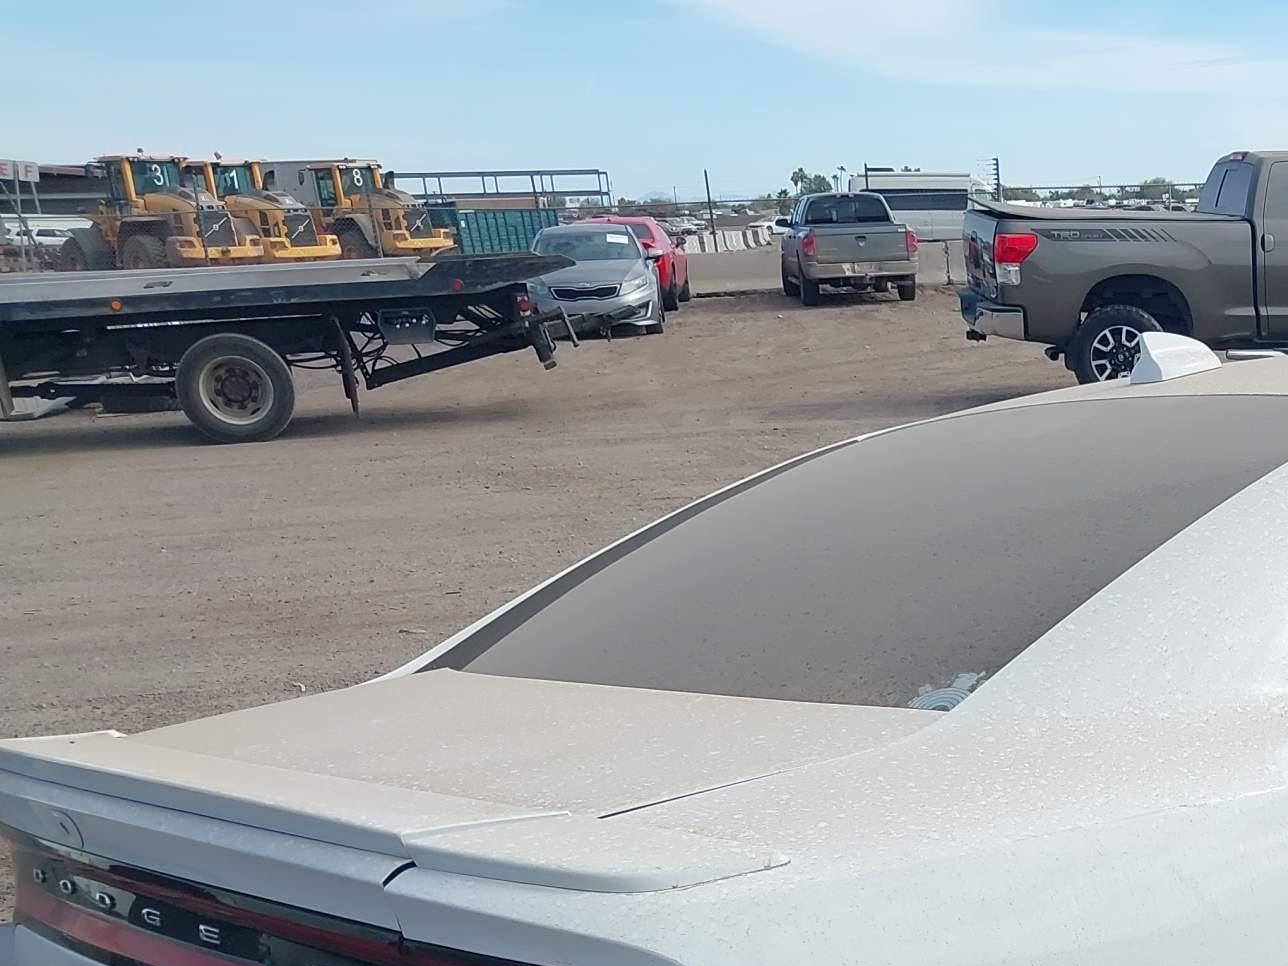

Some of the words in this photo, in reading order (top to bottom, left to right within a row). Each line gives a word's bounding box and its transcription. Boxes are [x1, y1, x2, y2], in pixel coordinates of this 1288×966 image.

[23, 164, 33, 177] F
[151, 163, 164, 186] 3
[229, 169, 240, 190] 1
[352, 168, 364, 187] 8
[1050, 231, 1080, 240] TRD
[33, 867, 221, 945] DODGE
